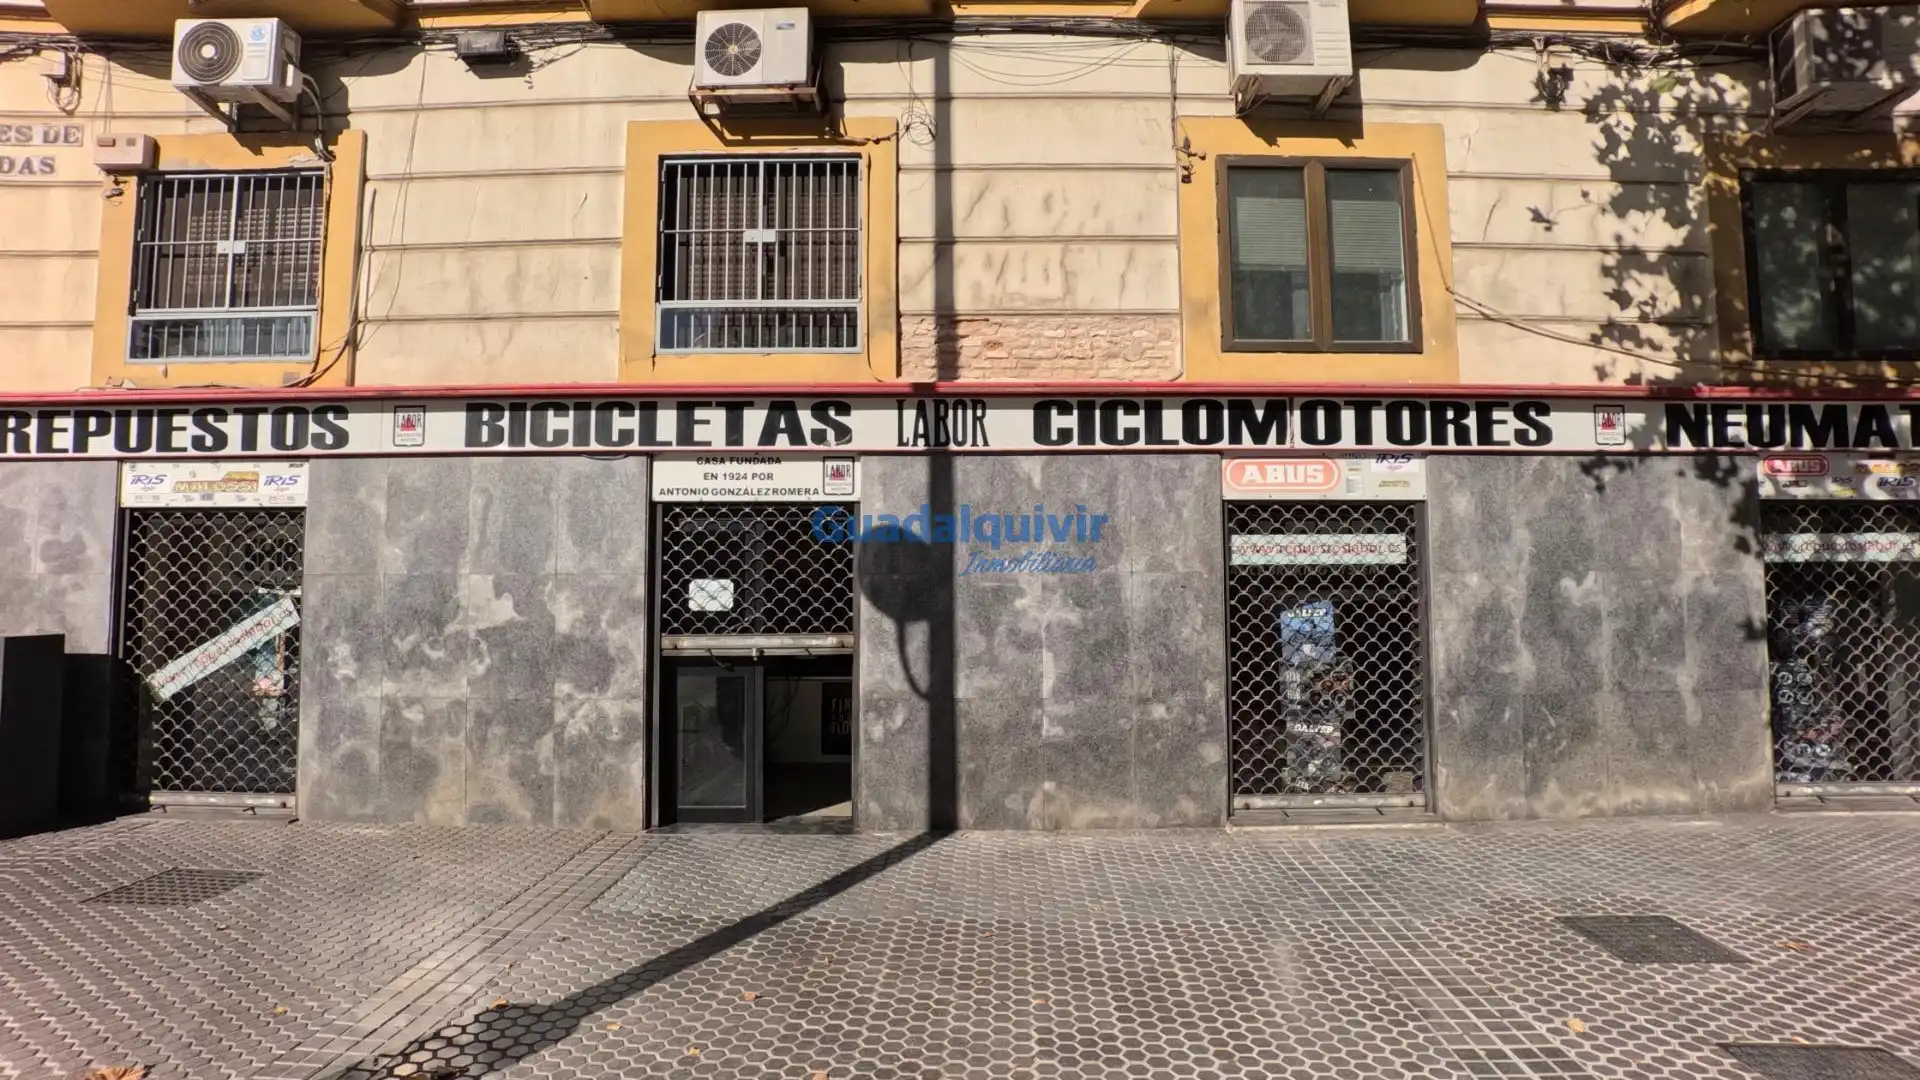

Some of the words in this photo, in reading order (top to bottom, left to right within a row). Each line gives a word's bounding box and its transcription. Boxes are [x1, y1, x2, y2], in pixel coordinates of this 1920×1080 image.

[41, 125, 81, 144] DE
[0, 156, 56, 175] DAS
[0, 405, 350, 454] REPUESTOS
[464, 400, 853, 448] BICICLETAS
[896, 398, 990, 448] LABOR
[1032, 398, 1554, 447] CICLOMOTORES
[1664, 403, 1920, 448] NEUMAT
[696, 456, 726, 465] CASA
[730, 456, 782, 465] FUNDADA
[703, 472, 718, 481] EN
[722, 472, 748, 481] 1924
[752, 472, 774, 481] POR
[1241, 464, 1325, 484] ABUS
[659, 487, 709, 496] ANTONIO
[711, 485, 770, 496] GONZÁLEZ
[772, 487, 820, 496] ROMERA
